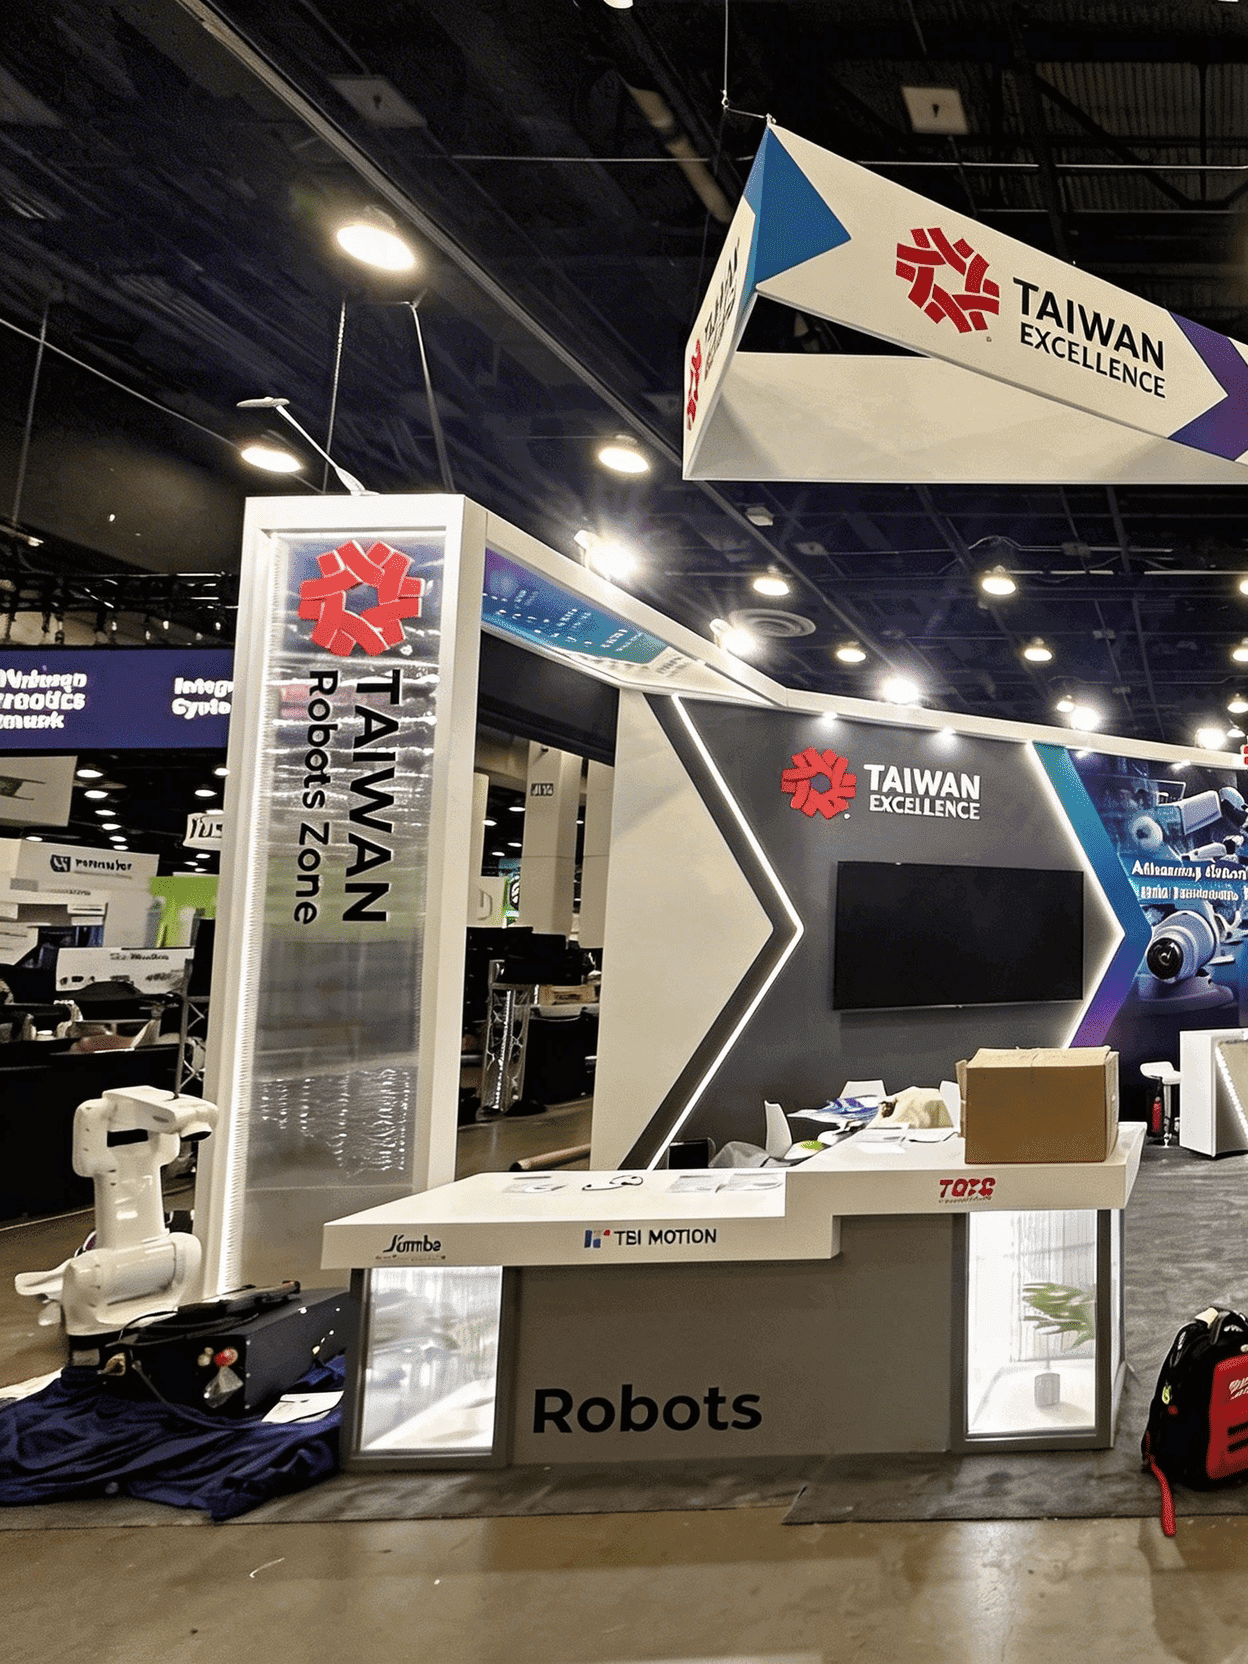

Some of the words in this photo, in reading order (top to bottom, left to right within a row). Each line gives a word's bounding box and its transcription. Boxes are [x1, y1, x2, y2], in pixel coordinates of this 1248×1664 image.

[1013, 276, 1164, 372] TAIWAN
[1020, 321, 1166, 400] EXCELLENCE
[302, 670, 339, 810] Robots
[342, 669, 401, 922] TAIWAN
[863, 763, 981, 801] TAIWAN
[869, 794, 981, 820] EXCELLENCE
[294, 821, 330, 925] Zone
[614, 1229, 642, 1246] TBI
[648, 1229, 717, 1245] MOTION
[532, 1383, 763, 1434] Robots
